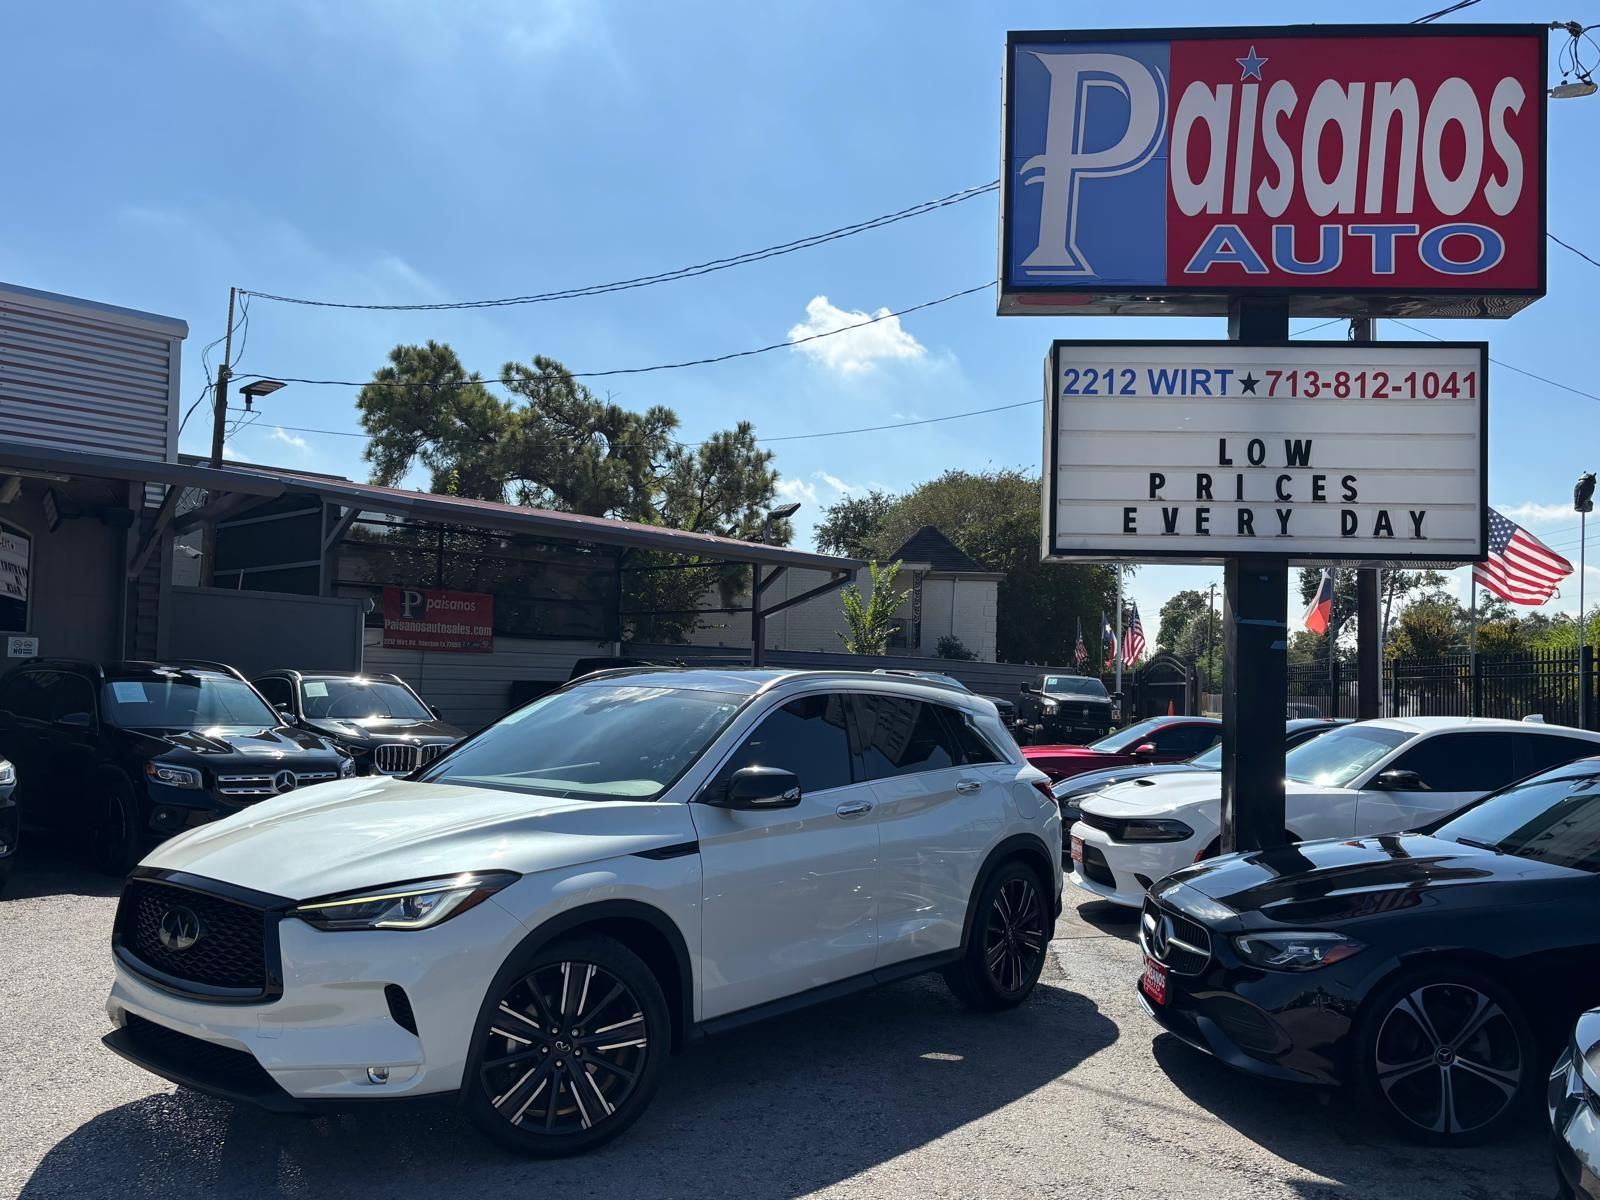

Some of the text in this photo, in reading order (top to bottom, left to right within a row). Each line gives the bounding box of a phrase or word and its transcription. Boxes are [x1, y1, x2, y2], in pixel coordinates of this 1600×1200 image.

[1183, 222, 1506, 276] AUTO
[1063, 368, 1476, 399] 2212 WIRT 713-812-1041
[1218, 438, 1313, 467] LOW
[1149, 472, 1358, 502] PRICES
[1123, 507, 1427, 538] EVERY DAY
[426, 595, 477, 612] paisanos
[384, 618, 492, 636] Paisanosautosales.com
